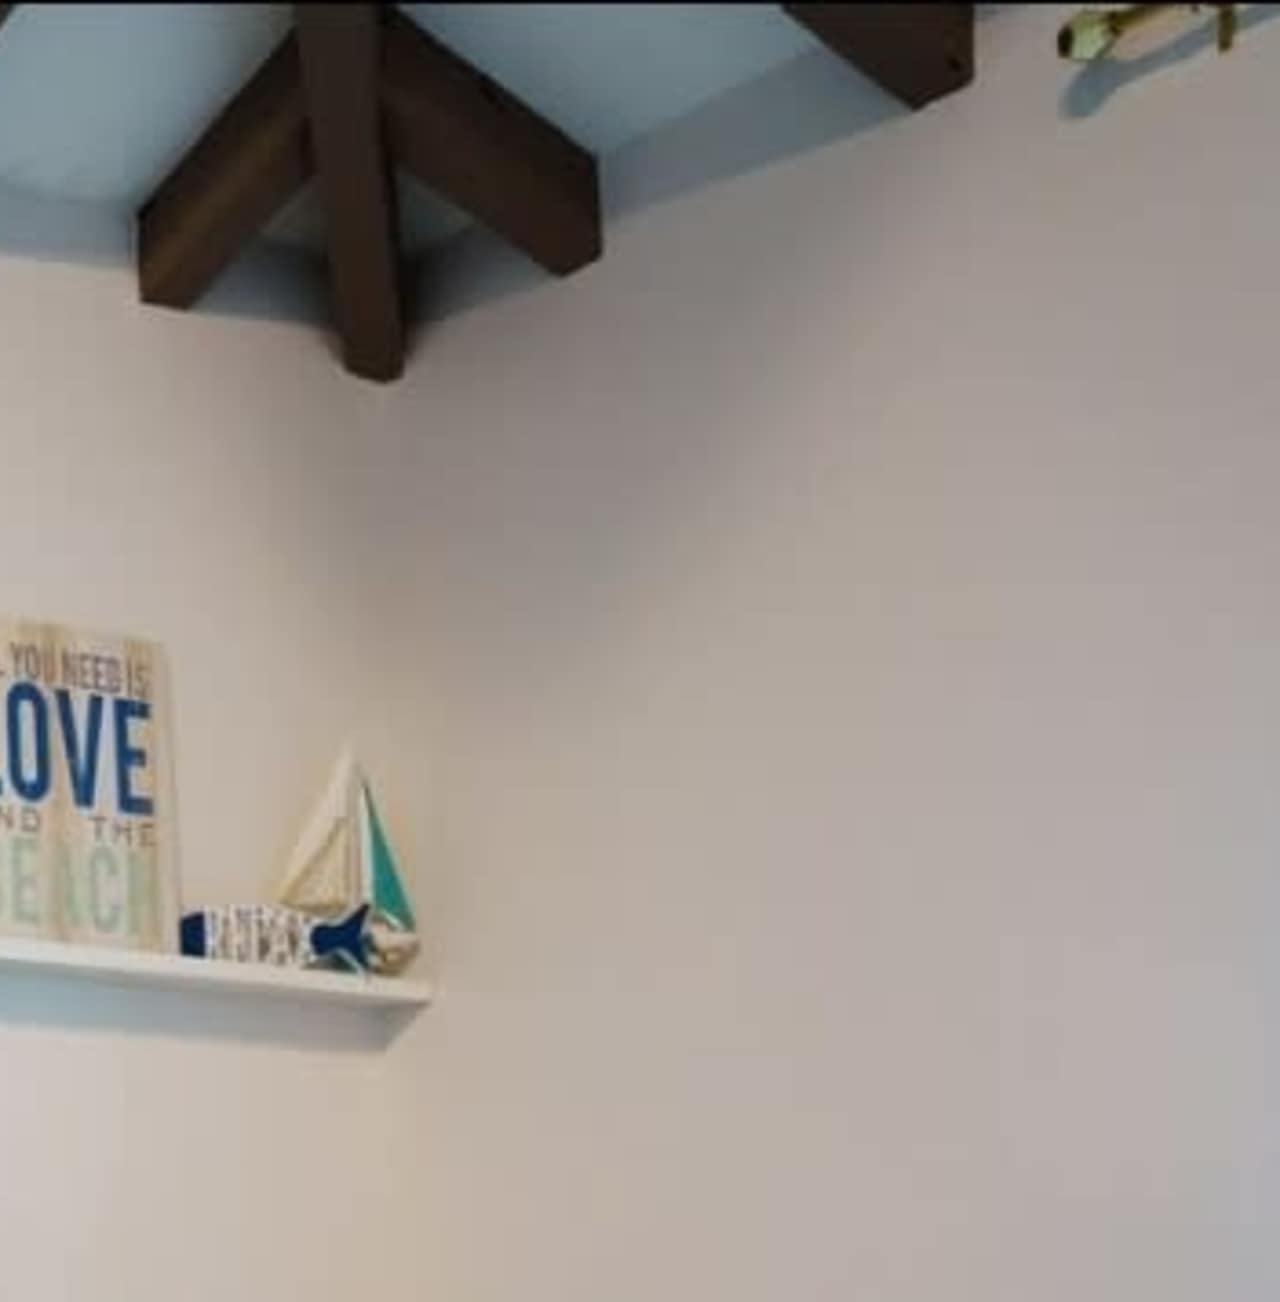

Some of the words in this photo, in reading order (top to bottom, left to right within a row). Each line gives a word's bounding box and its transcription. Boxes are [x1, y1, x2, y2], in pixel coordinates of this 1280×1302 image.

[10, 641, 58, 681] YOU
[62, 645, 122, 694] NEED
[126, 658, 152, 699] IS
[90, 814, 156, 848] THE
